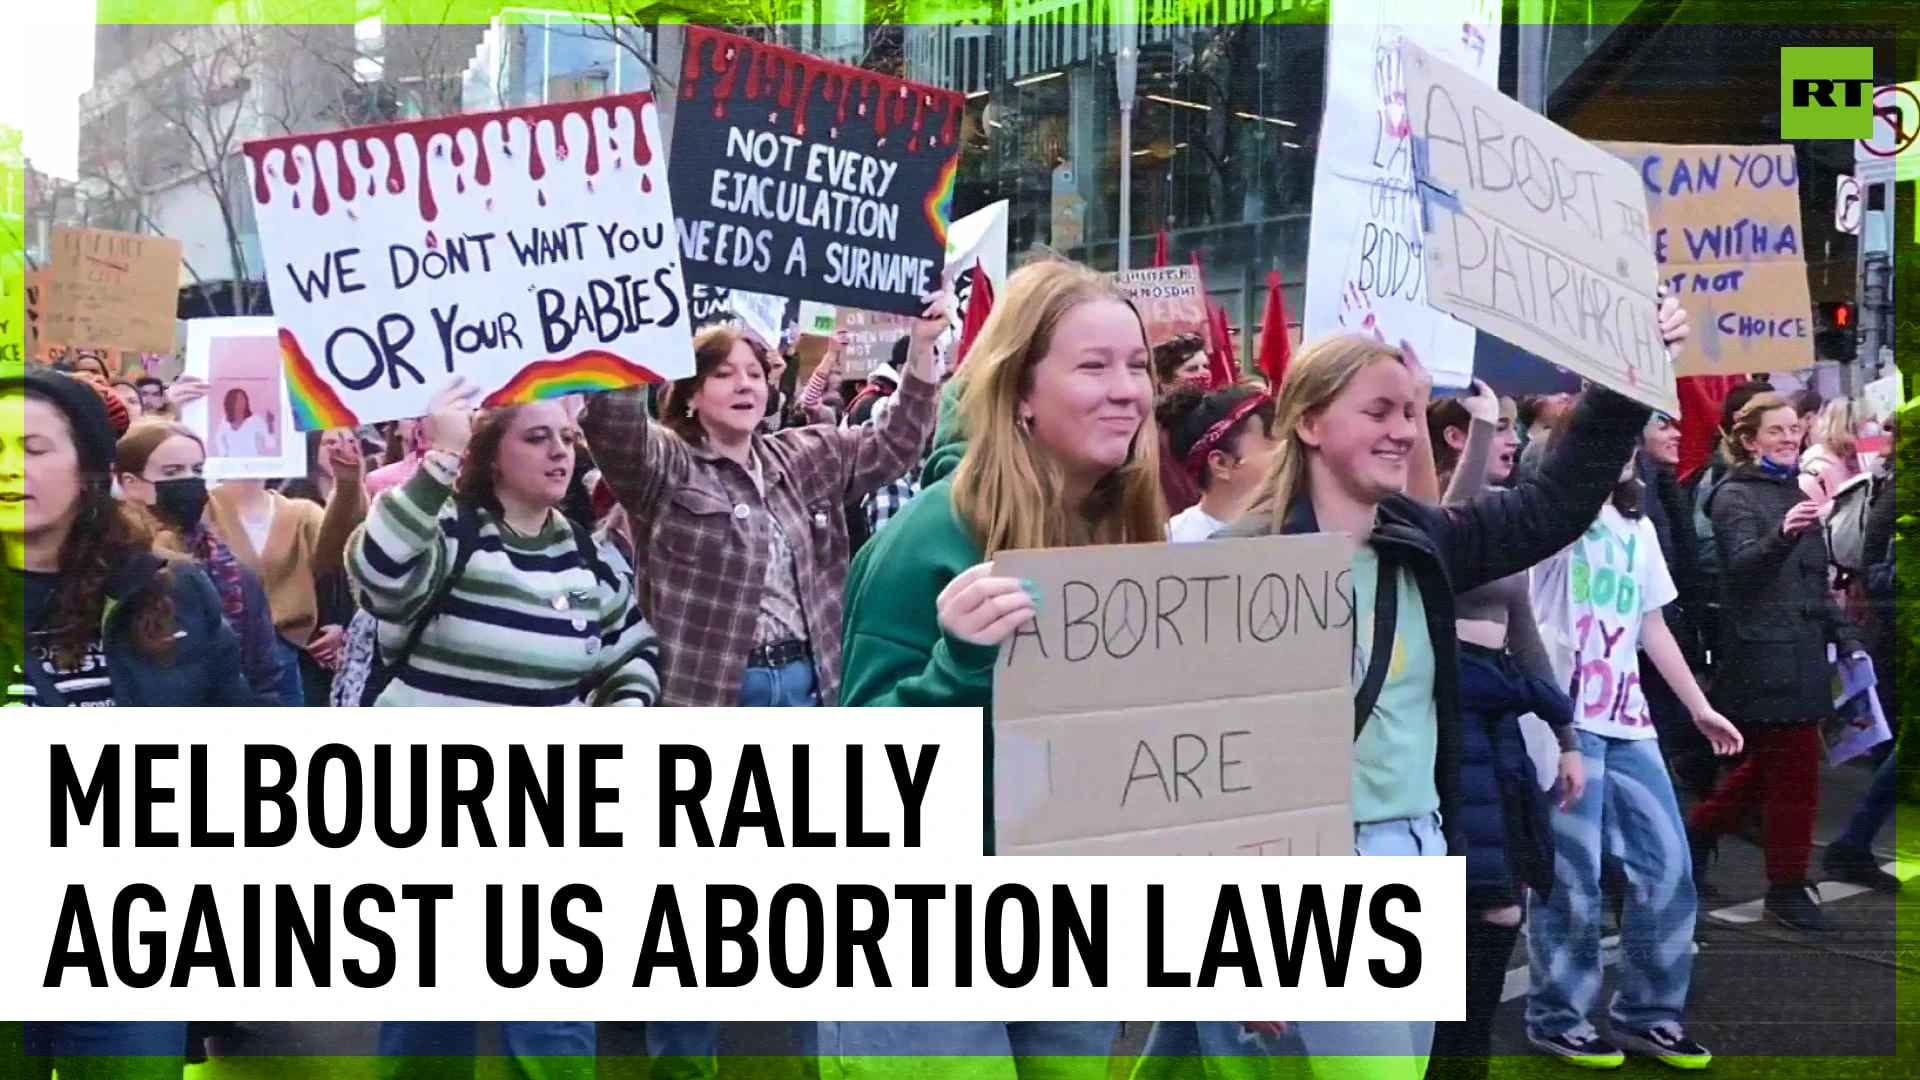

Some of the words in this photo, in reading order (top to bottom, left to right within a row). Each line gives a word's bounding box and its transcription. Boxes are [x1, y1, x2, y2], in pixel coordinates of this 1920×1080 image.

[727, 126, 802, 171] NOT
[805, 143, 898, 197] EVERY
[1424, 83, 1604, 241] ABORT
[1642, 154, 1721, 196] CAN
[1728, 153, 1799, 189] YOU
[710, 168, 899, 241] EJACULATION
[1683, 217, 1768, 260] WITH
[1773, 224, 1797, 255] A
[287, 248, 366, 302] WE
[507, 222, 588, 267] WANT
[597, 222, 664, 259] YOU
[675, 216, 773, 273] NEEDS
[784, 236, 807, 277] A
[823, 241, 935, 296] SURNAME
[1358, 223, 1422, 301] BODY
[1691, 270, 1744, 293] NOT
[325, 313, 425, 390] OR
[430, 303, 523, 373] YOUR
[1717, 311, 1808, 338] CHOICE
[1007, 567, 1354, 667] ABORTIONS
[1120, 730, 1252, 807] ARE
